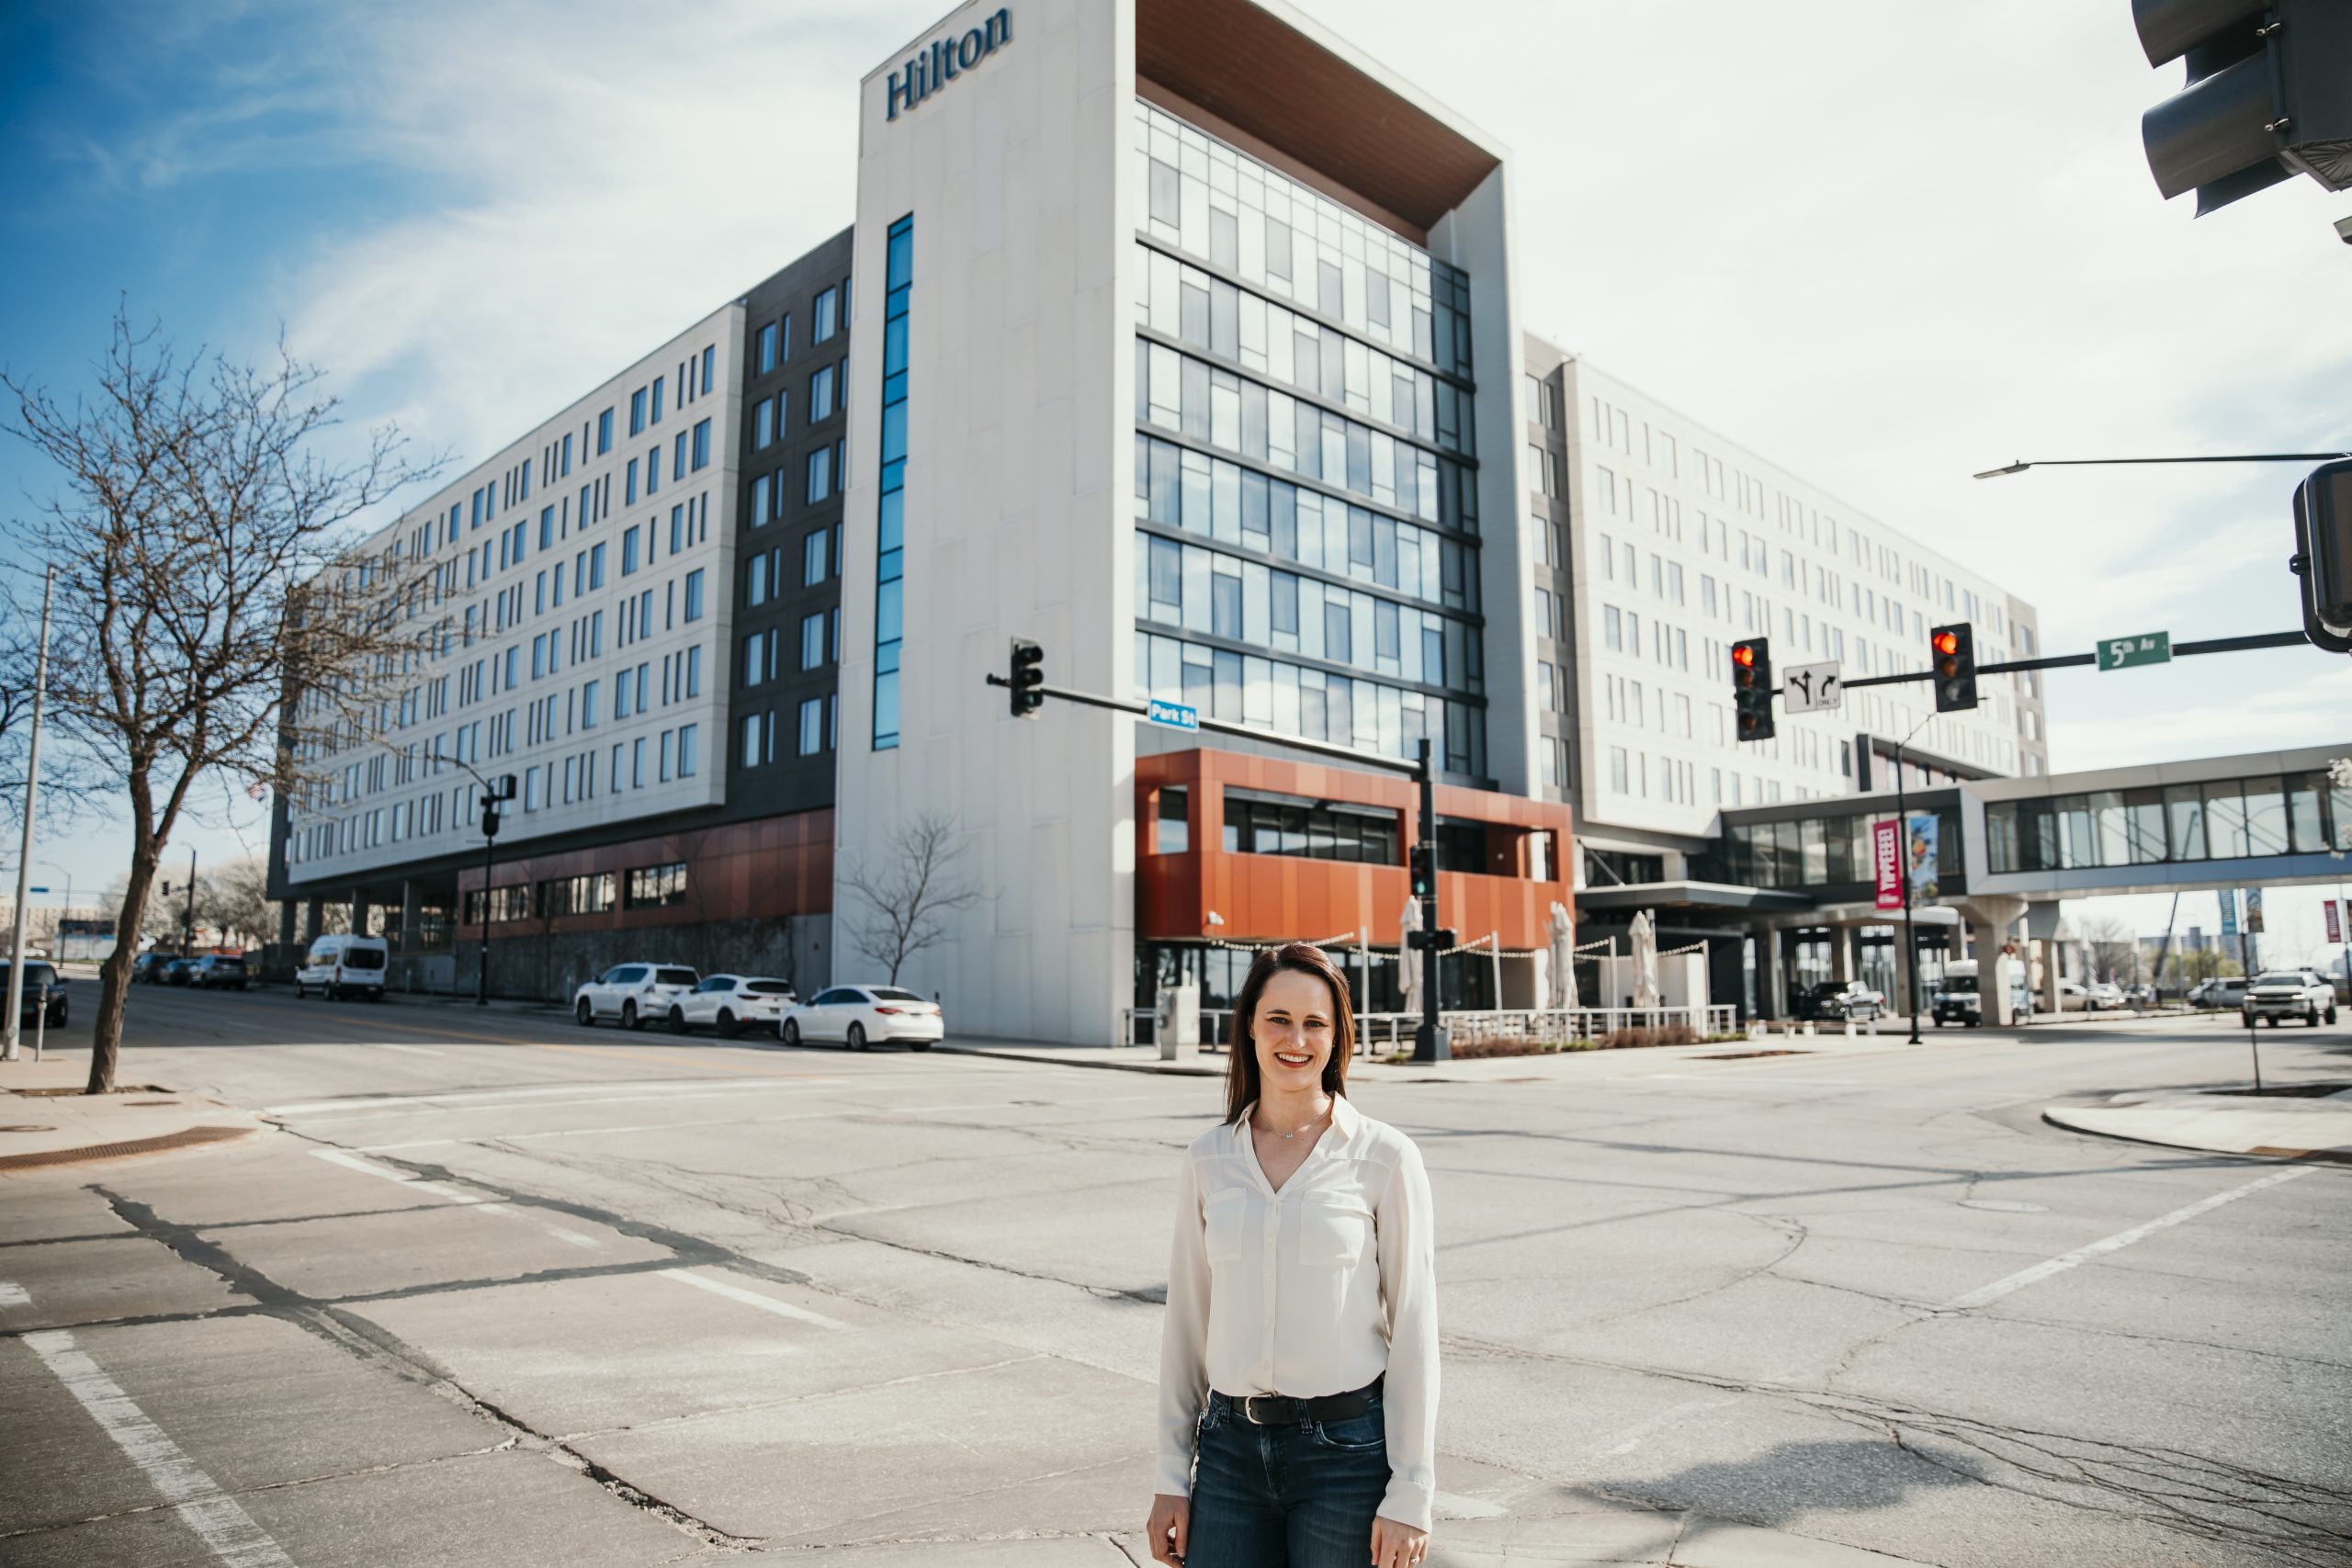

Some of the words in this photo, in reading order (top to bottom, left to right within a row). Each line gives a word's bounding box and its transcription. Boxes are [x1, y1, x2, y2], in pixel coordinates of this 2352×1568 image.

[887, 7, 1012, 122] Hilton
[1152, 704, 1180, 722] Park
[1181, 709, 1194, 726] St
